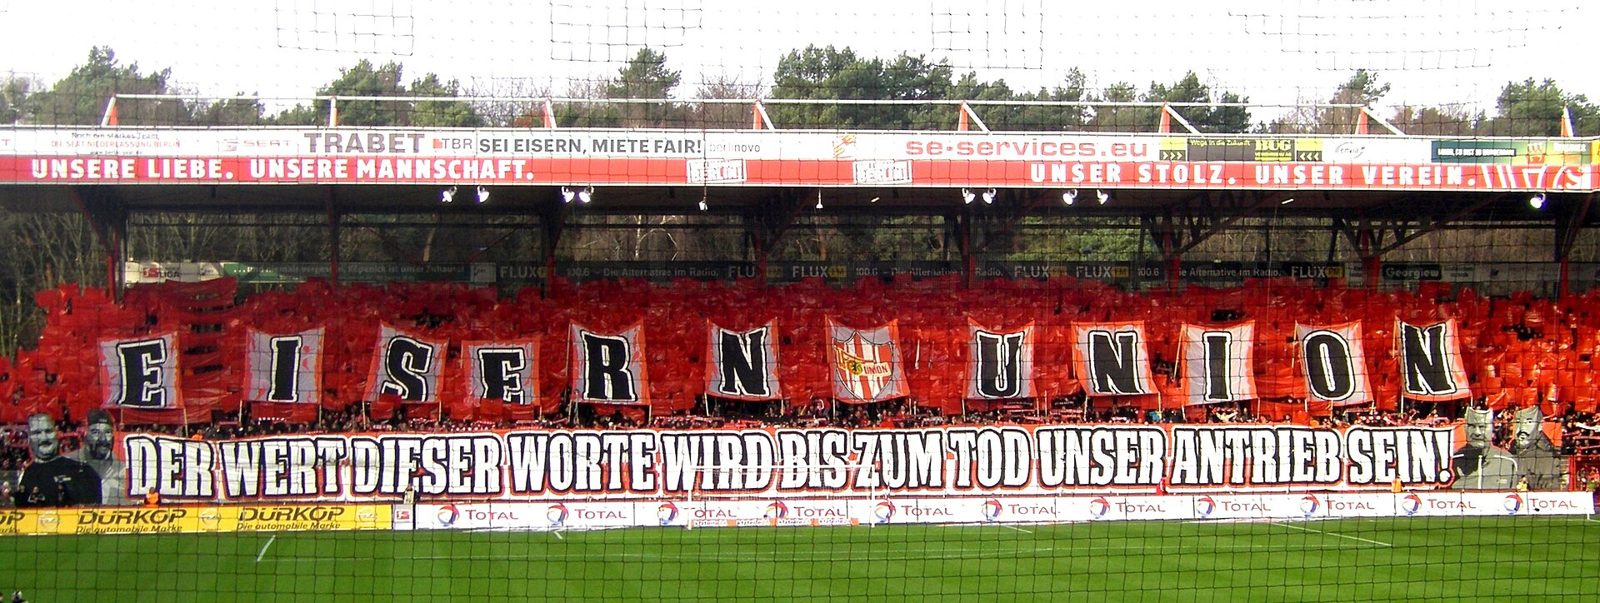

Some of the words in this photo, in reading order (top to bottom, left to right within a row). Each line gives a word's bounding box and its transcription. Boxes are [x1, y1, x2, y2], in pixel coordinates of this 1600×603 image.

[304, 132, 425, 154] TRABET
[442, 138, 472, 150] TBR
[479, 138, 509, 153] SEI
[514, 138, 588, 155] EISERN,
[592, 139, 649, 154] MIETE
[654, 139, 702, 154] FAIR!
[31, 158, 136, 179] UNSERE
[147, 158, 234, 180] LIEBE.
[250, 158, 348, 179] UNSERE
[356, 159, 535, 181] MANNSCHAFT.
[1030, 163, 1121, 183] UNSER
[1138, 163, 1236, 185] STOLZ.
[1254, 165, 1344, 185] UNSER
[1361, 165, 1476, 187] VEREIN.
[728, 265, 757, 279] FLU
[1189, 266, 1236, 277] Alternative
[1239, 267, 1250, 277] im
[1386, 267, 1440, 280] Georgiew
[863, 364, 888, 376] UNION
[127, 436, 215, 497] DER
[220, 437, 347, 497] WERT
[351, 435, 503, 495] DIESER
[508, 432, 657, 492] WORTE
[661, 431, 777, 492] WIRD
[777, 430, 849, 490] BIS
[853, 430, 945, 489] ZUM
[948, 429, 1031, 488] TOD
[1036, 427, 1167, 487] UNSER
[1170, 427, 1343, 486] ANTRIEB
[1347, 426, 1454, 486] SEIN!
[151, 524, 183, 533] Marke
[237, 522, 252, 531] Die
[255, 521, 308, 531] automobile
[309, 520, 341, 530] Marke
